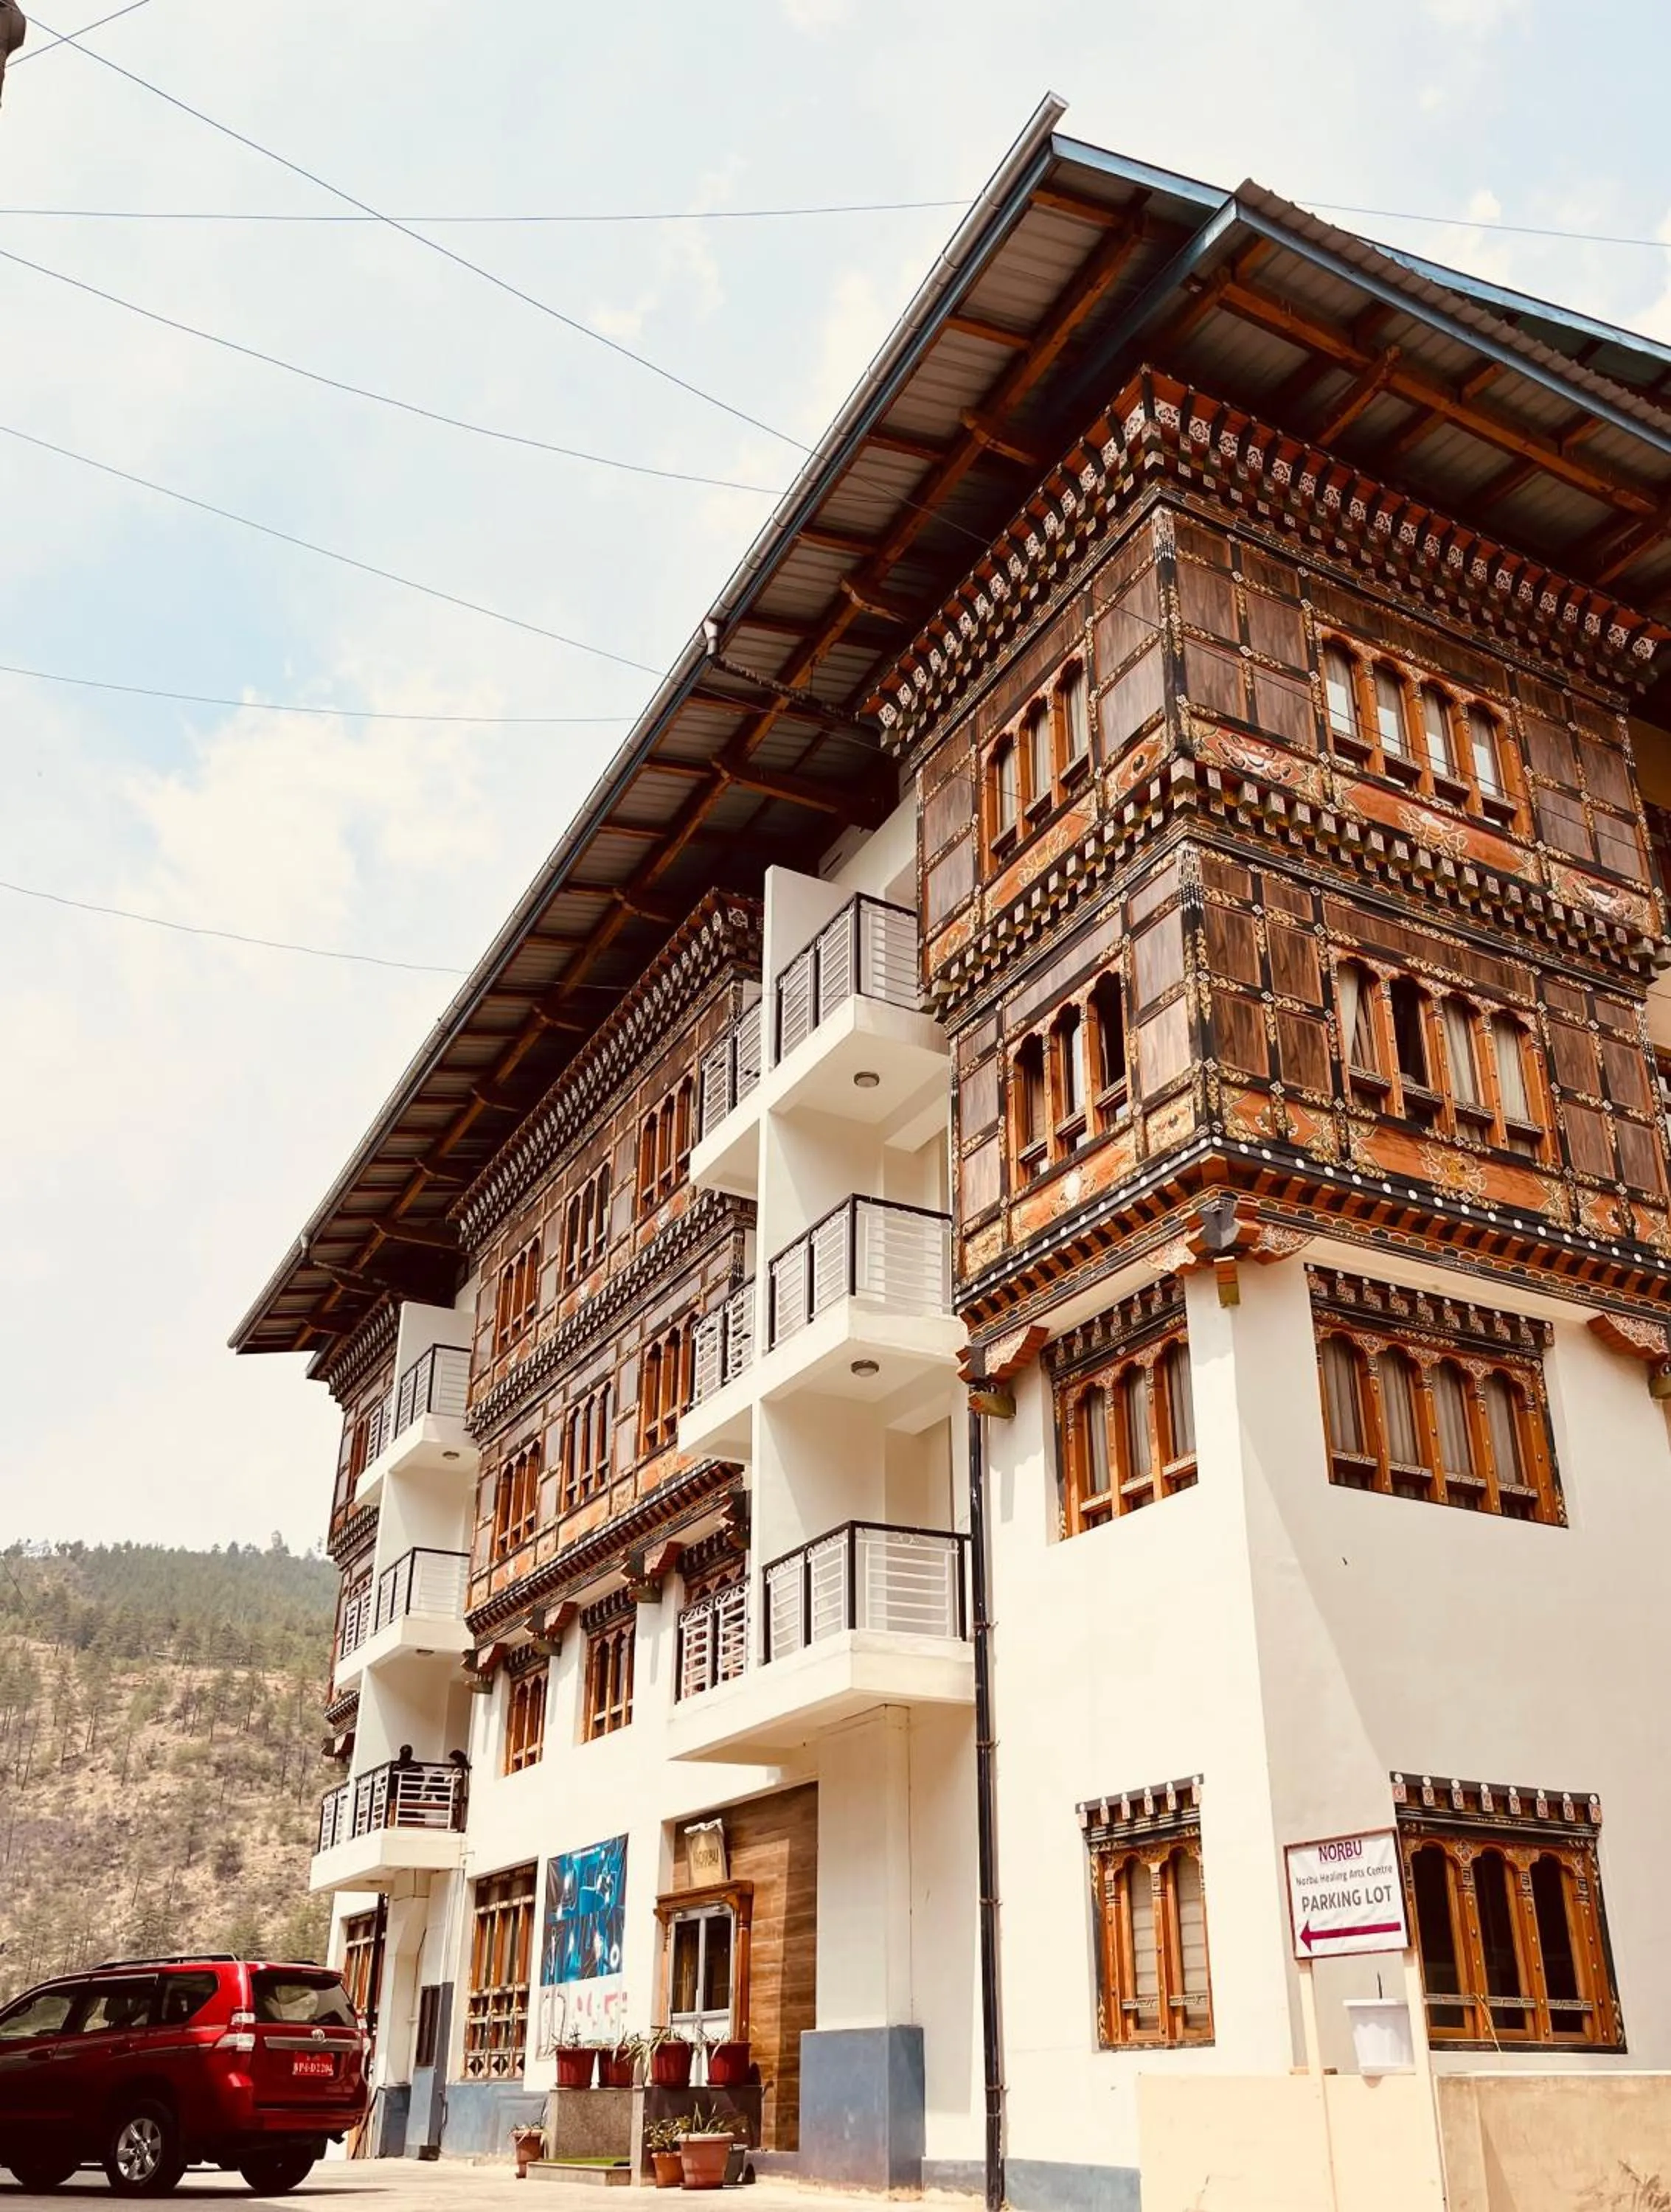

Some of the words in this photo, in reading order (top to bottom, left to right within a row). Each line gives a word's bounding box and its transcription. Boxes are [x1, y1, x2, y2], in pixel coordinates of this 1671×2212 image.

[1319, 1840, 1362, 1862] NORBU
[1296, 1876, 1319, 1885] Norbu
[1320, 1871, 1347, 1882] Healing
[1349, 1868, 1365, 1879] Arts
[1366, 1865, 1393, 1877] Centre
[1302, 1889, 1361, 1912] PARKING
[1365, 1885, 1392, 1904] LOT
